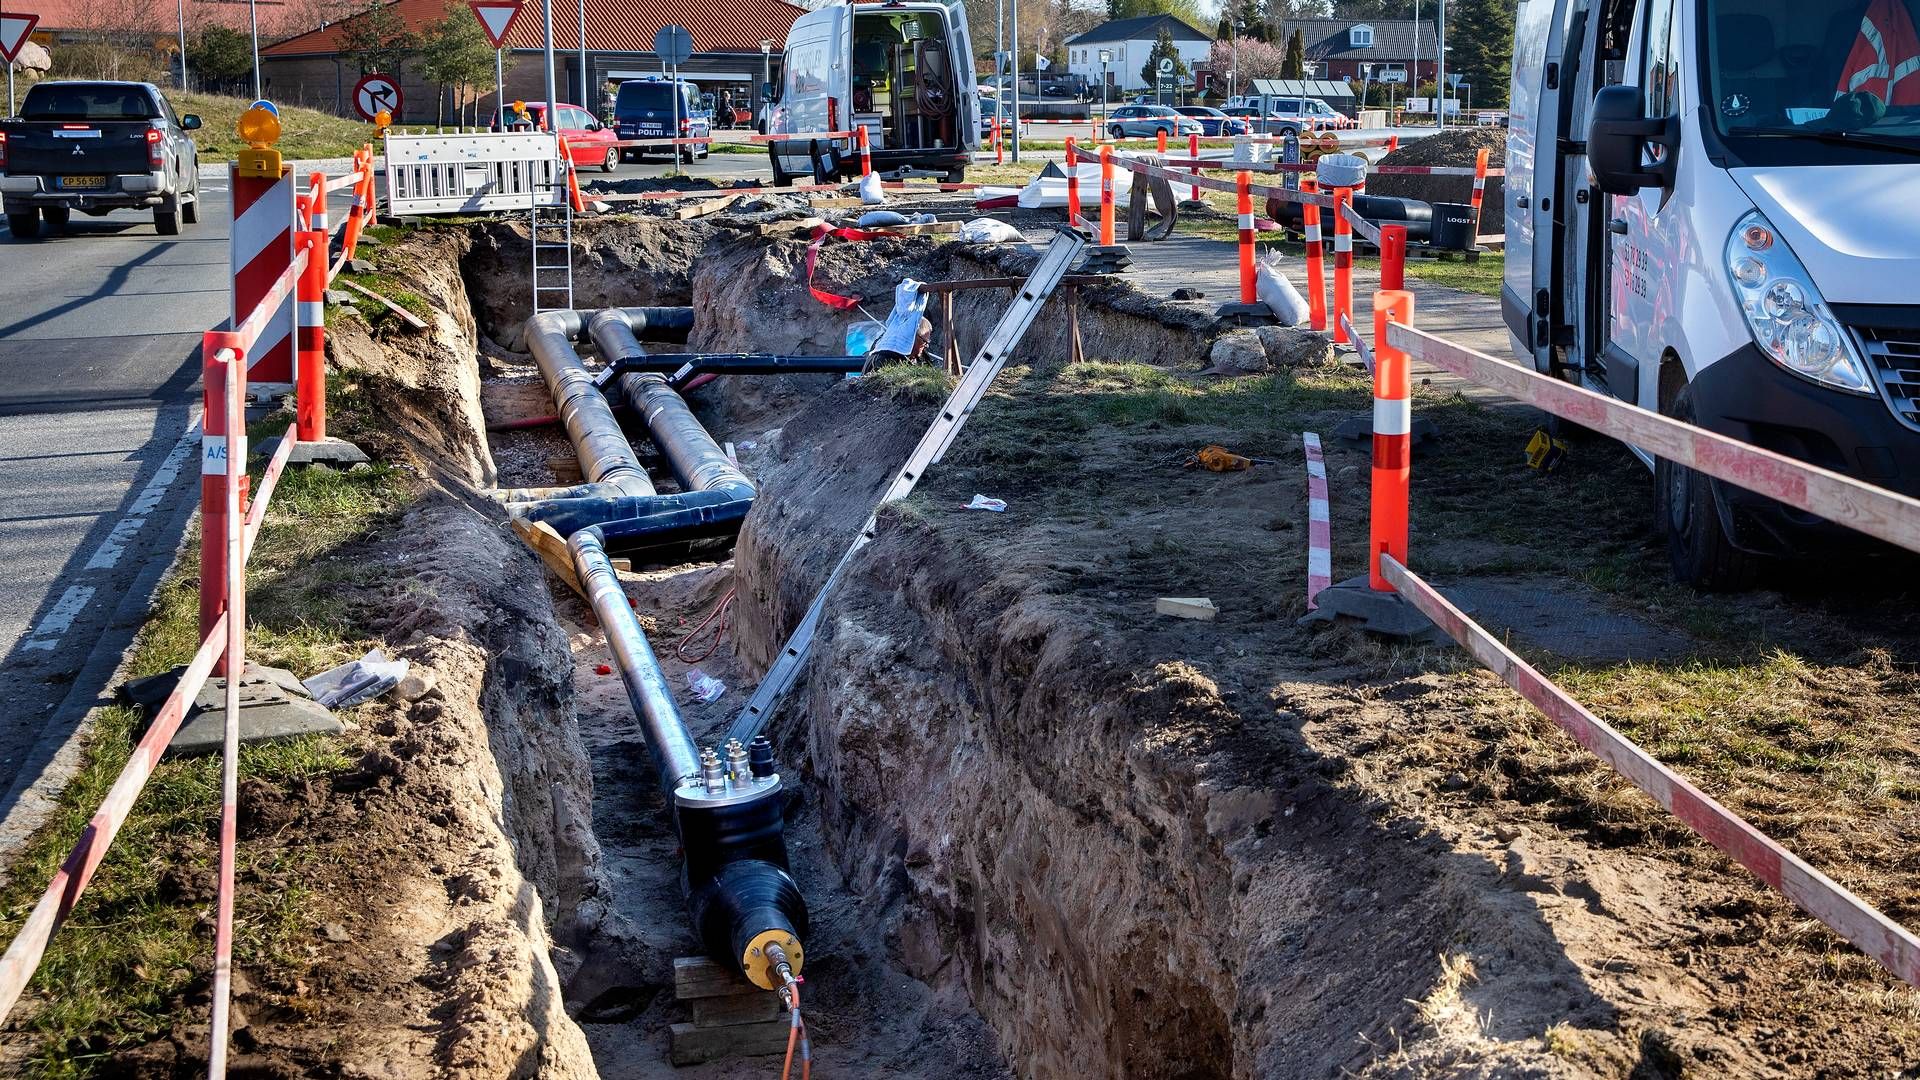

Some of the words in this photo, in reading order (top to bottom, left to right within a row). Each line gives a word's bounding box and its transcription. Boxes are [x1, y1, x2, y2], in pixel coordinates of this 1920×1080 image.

[63, 177, 74, 186] CP
[76, 177, 87, 186] 56
[207, 446, 227, 459] A/S
